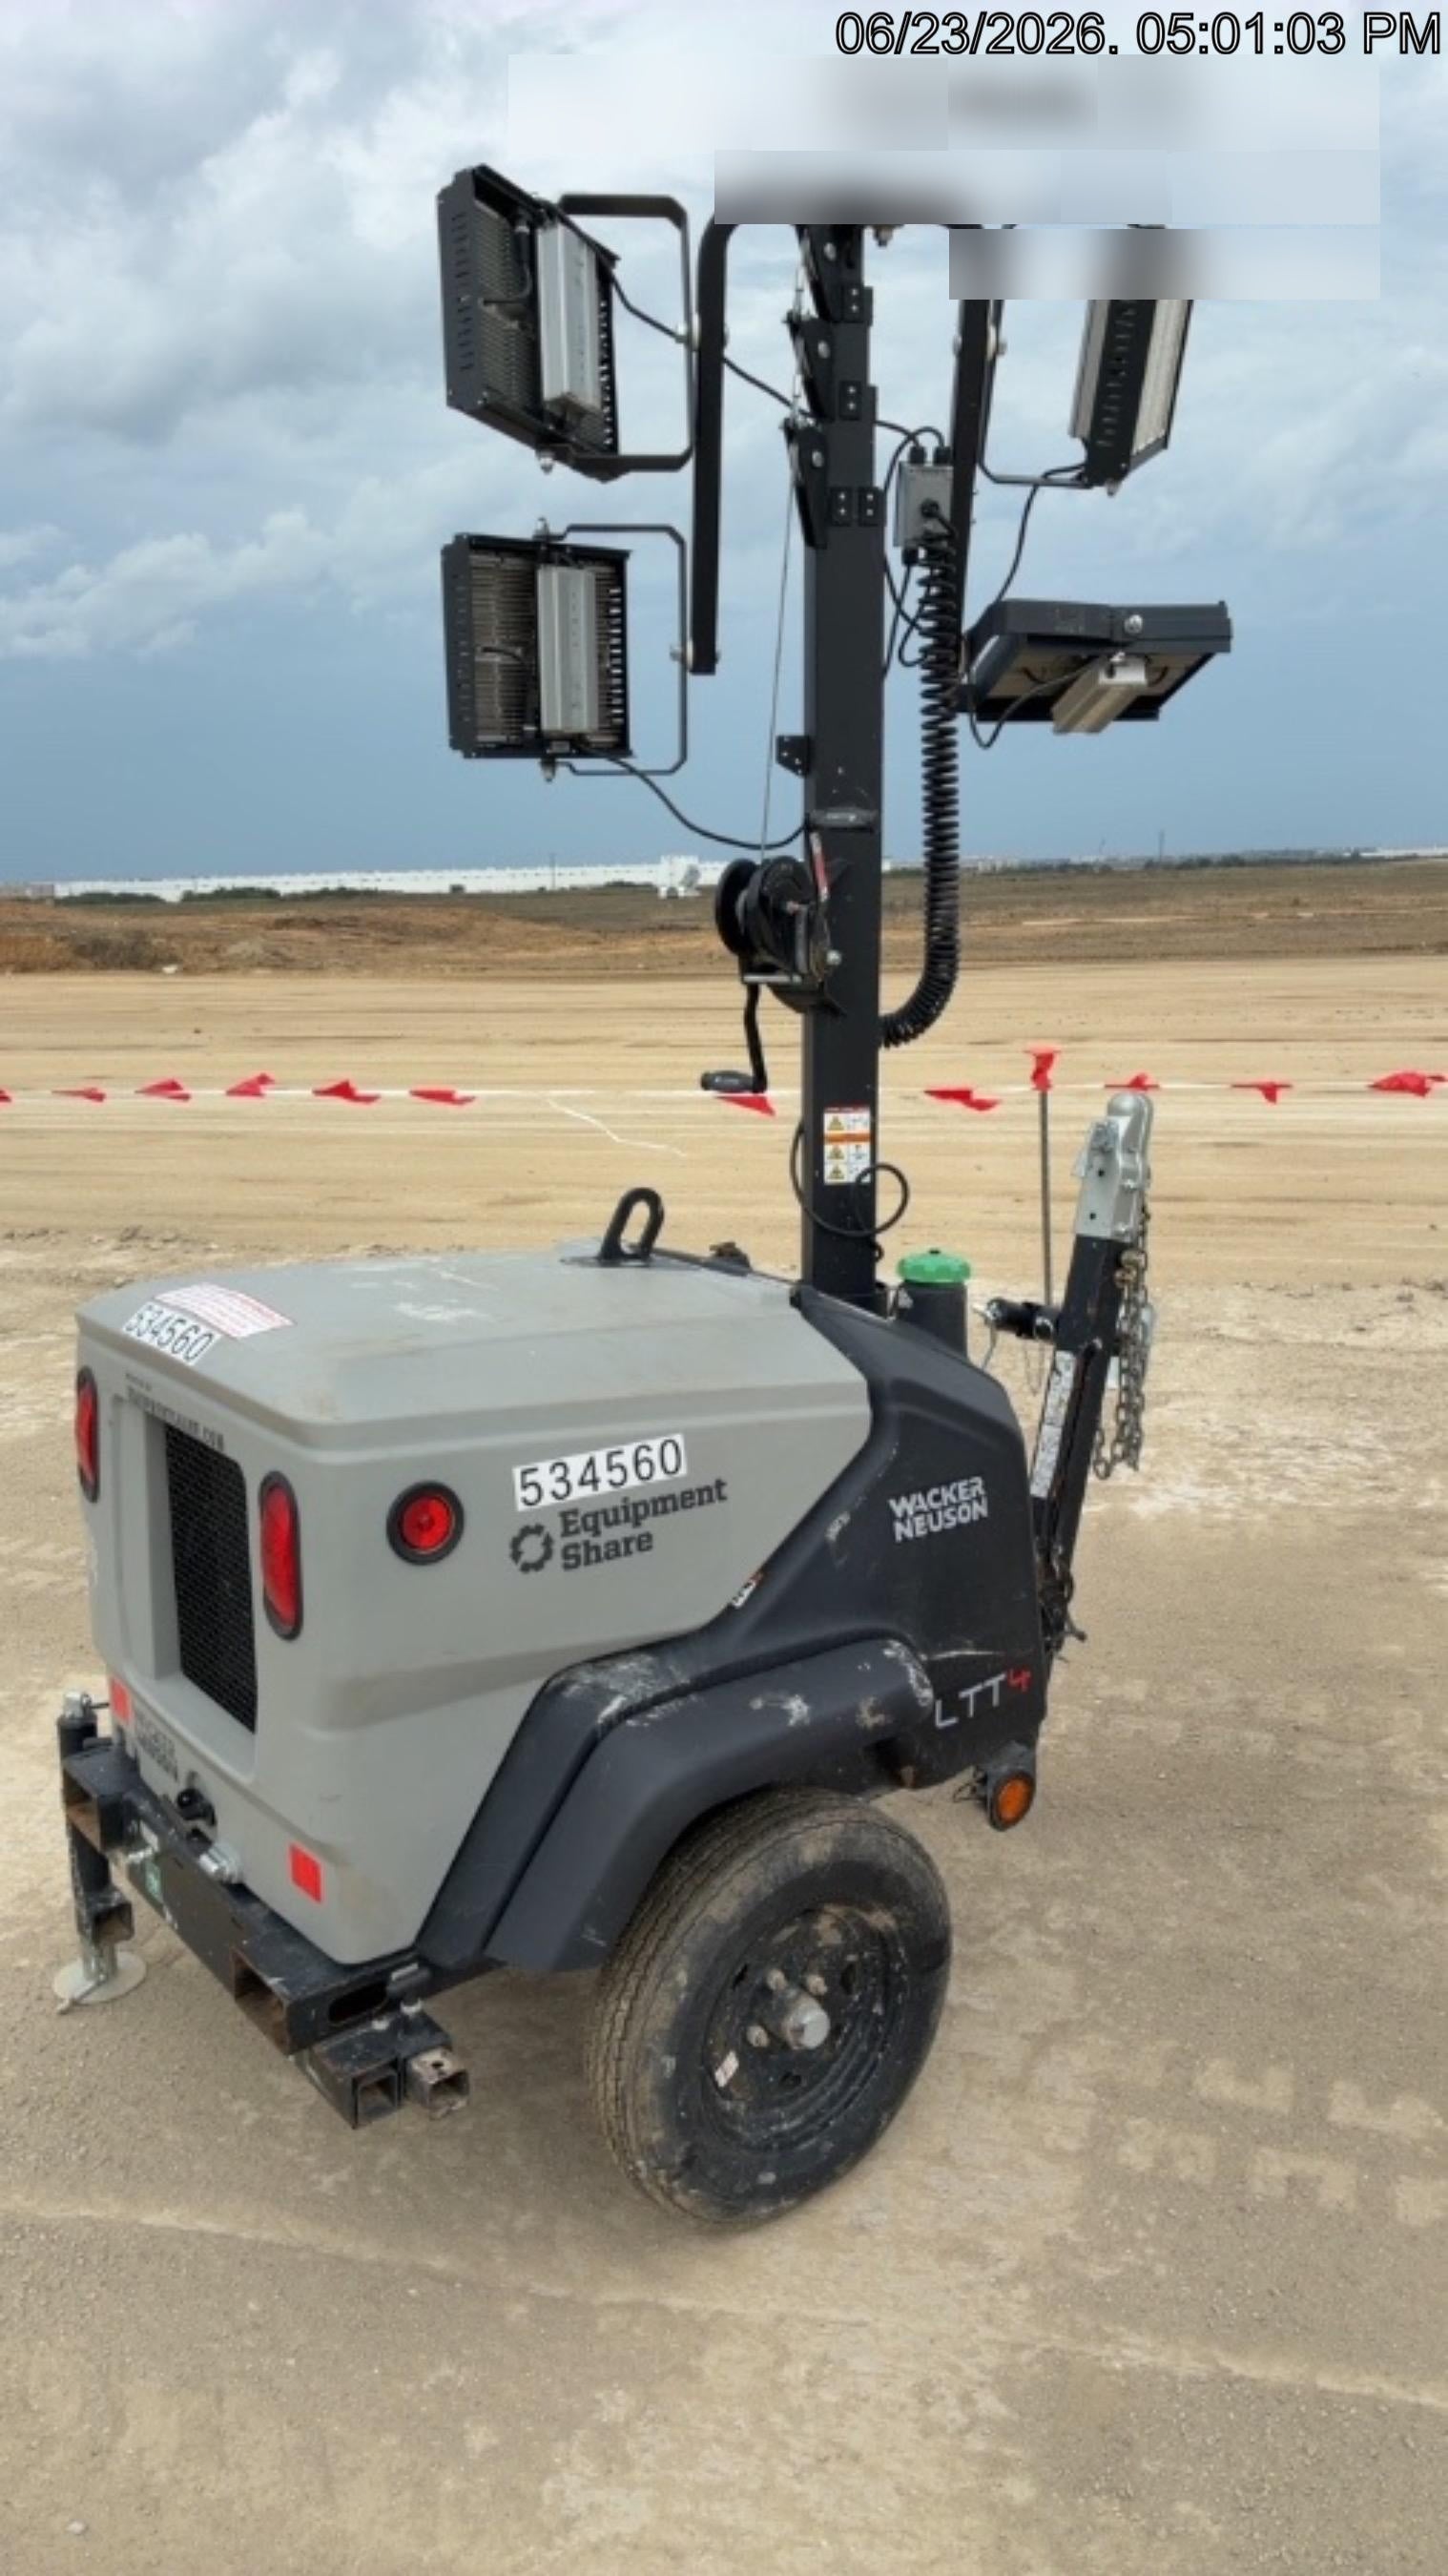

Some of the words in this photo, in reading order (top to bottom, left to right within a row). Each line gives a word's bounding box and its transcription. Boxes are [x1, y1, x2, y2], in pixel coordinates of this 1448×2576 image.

[520, 1439, 683, 1506] 534560
[888, 1477, 985, 1518] WACKER
[559, 1478, 728, 1538] Equipment
[894, 1495, 988, 1543] NEUSON
[561, 1530, 653, 1571] Share
[935, 1668, 1032, 1730] LTT4
